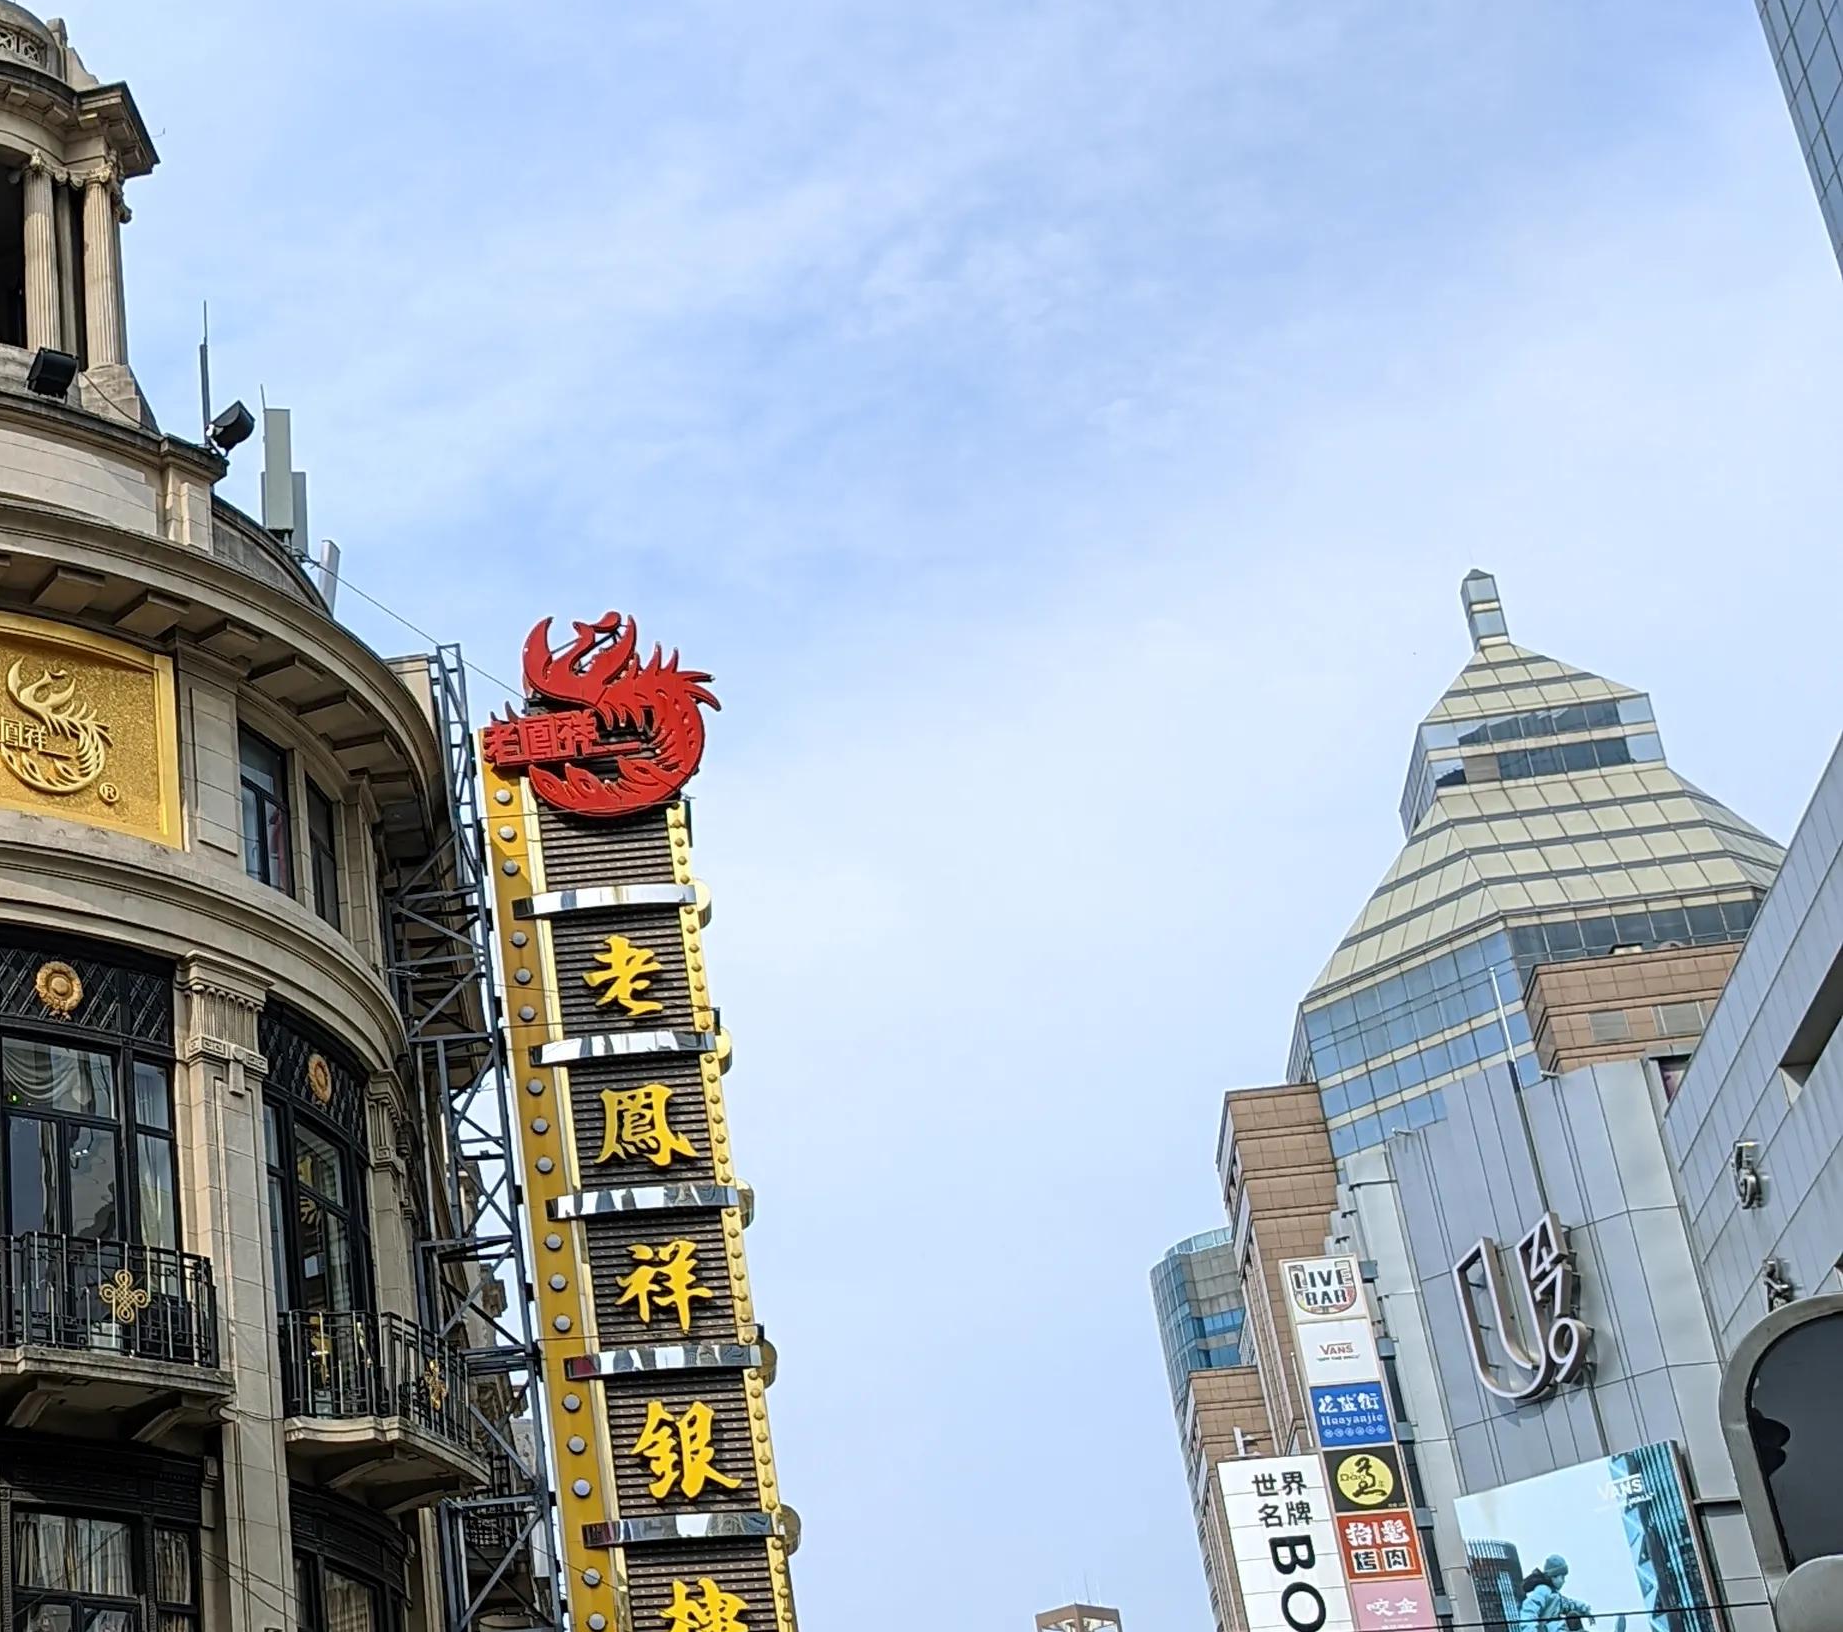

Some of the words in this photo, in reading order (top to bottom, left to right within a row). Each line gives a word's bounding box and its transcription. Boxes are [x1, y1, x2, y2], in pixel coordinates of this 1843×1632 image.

[1319, 1341, 1354, 1356] VANS
[1252, 1471, 1308, 1497] 世界
[1258, 1501, 1314, 1529] 名牌
